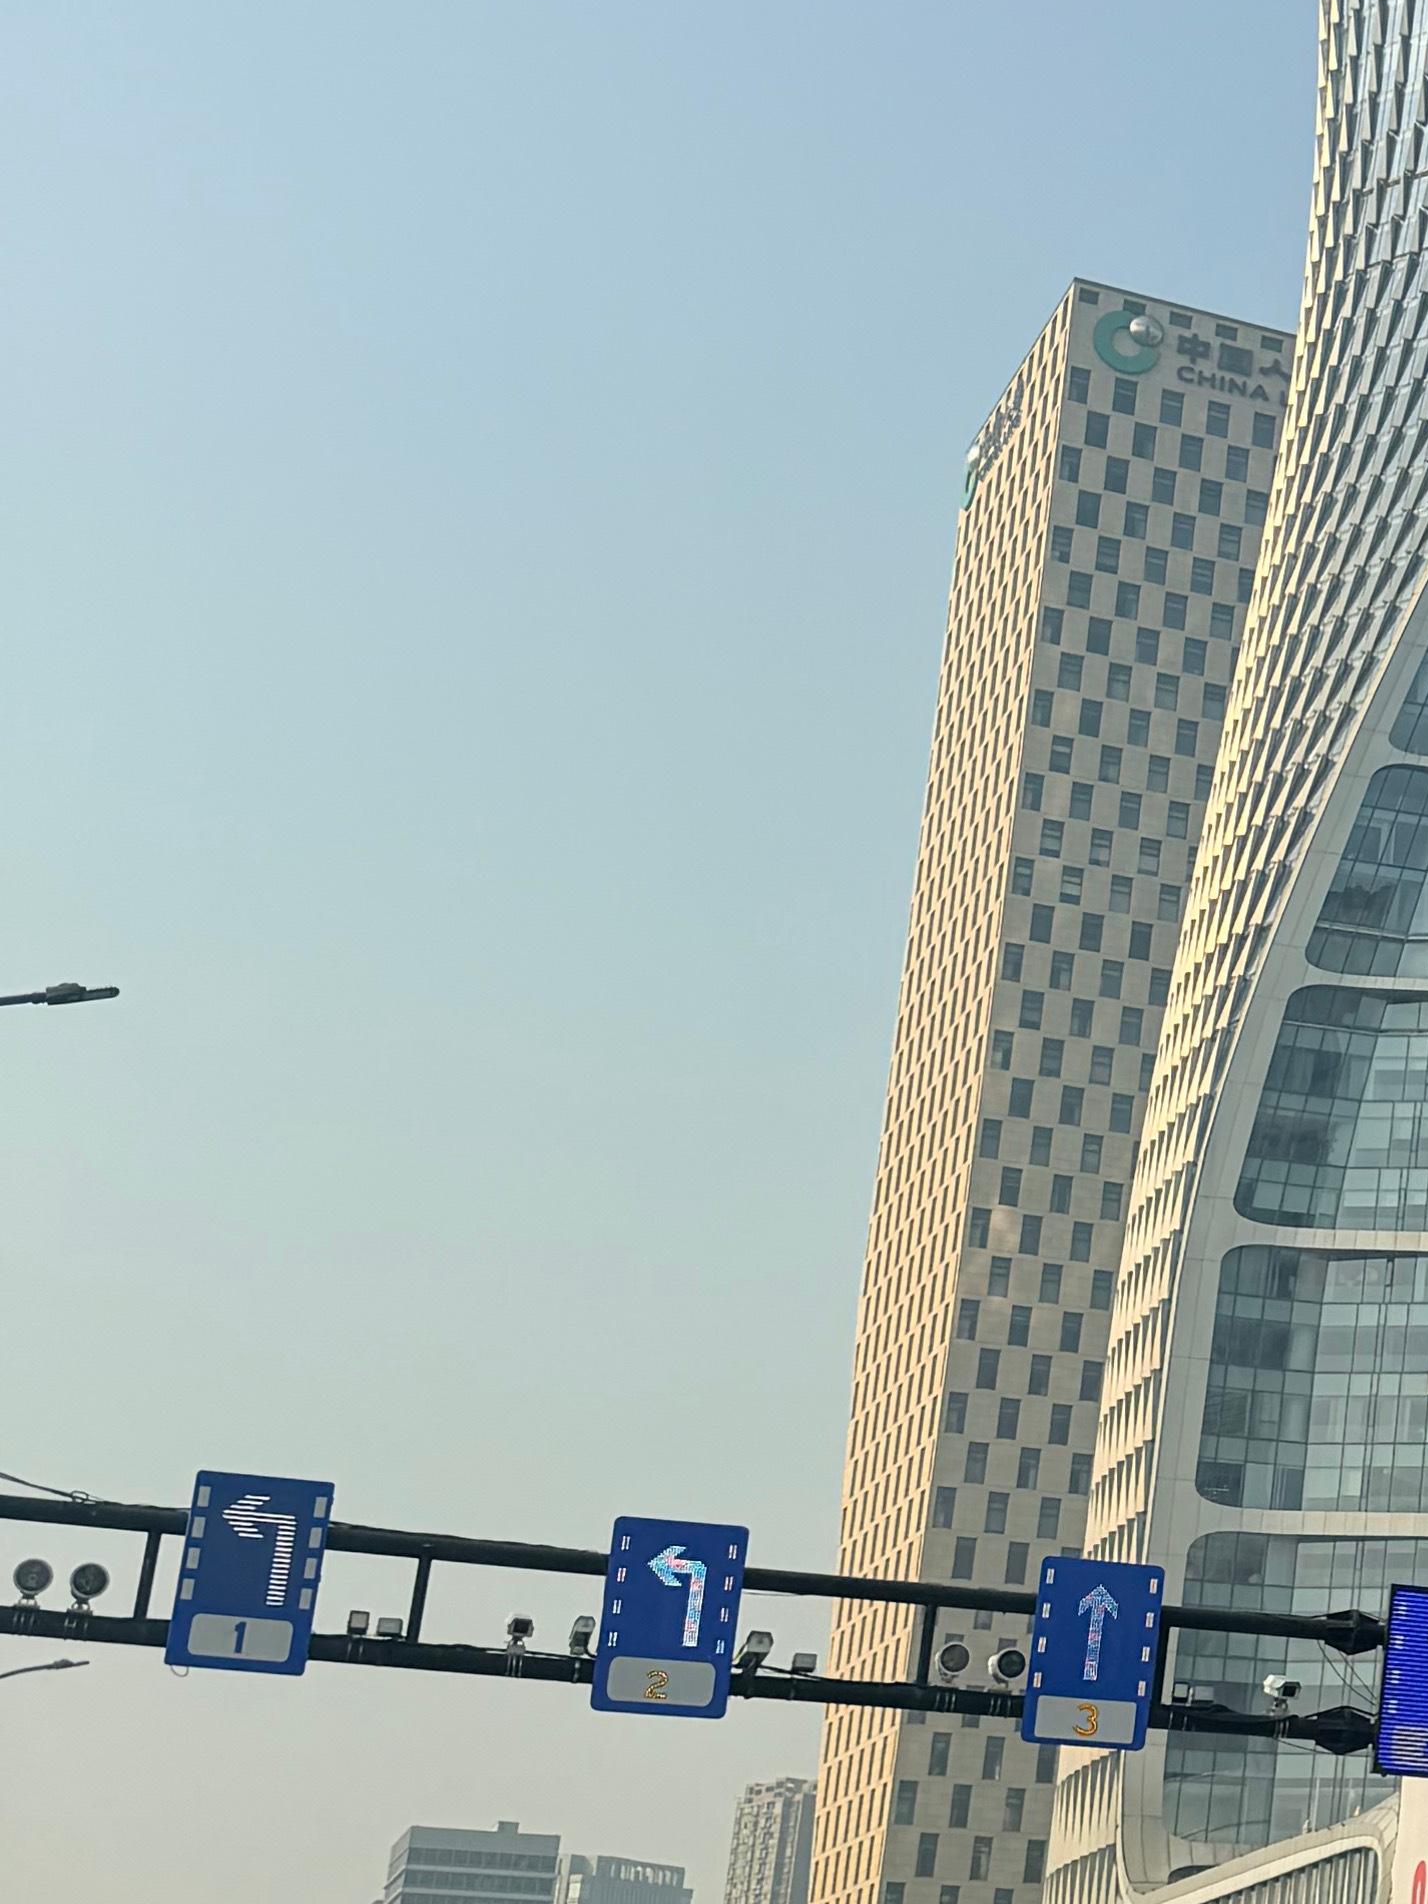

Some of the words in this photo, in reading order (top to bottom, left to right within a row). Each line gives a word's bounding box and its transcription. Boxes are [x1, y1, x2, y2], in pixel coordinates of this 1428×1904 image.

[1176, 365, 1270, 402] CHINA
[233, 1621, 247, 1654] 1
[644, 1670, 669, 1699] 2
[1073, 1702, 1098, 1736] 3
